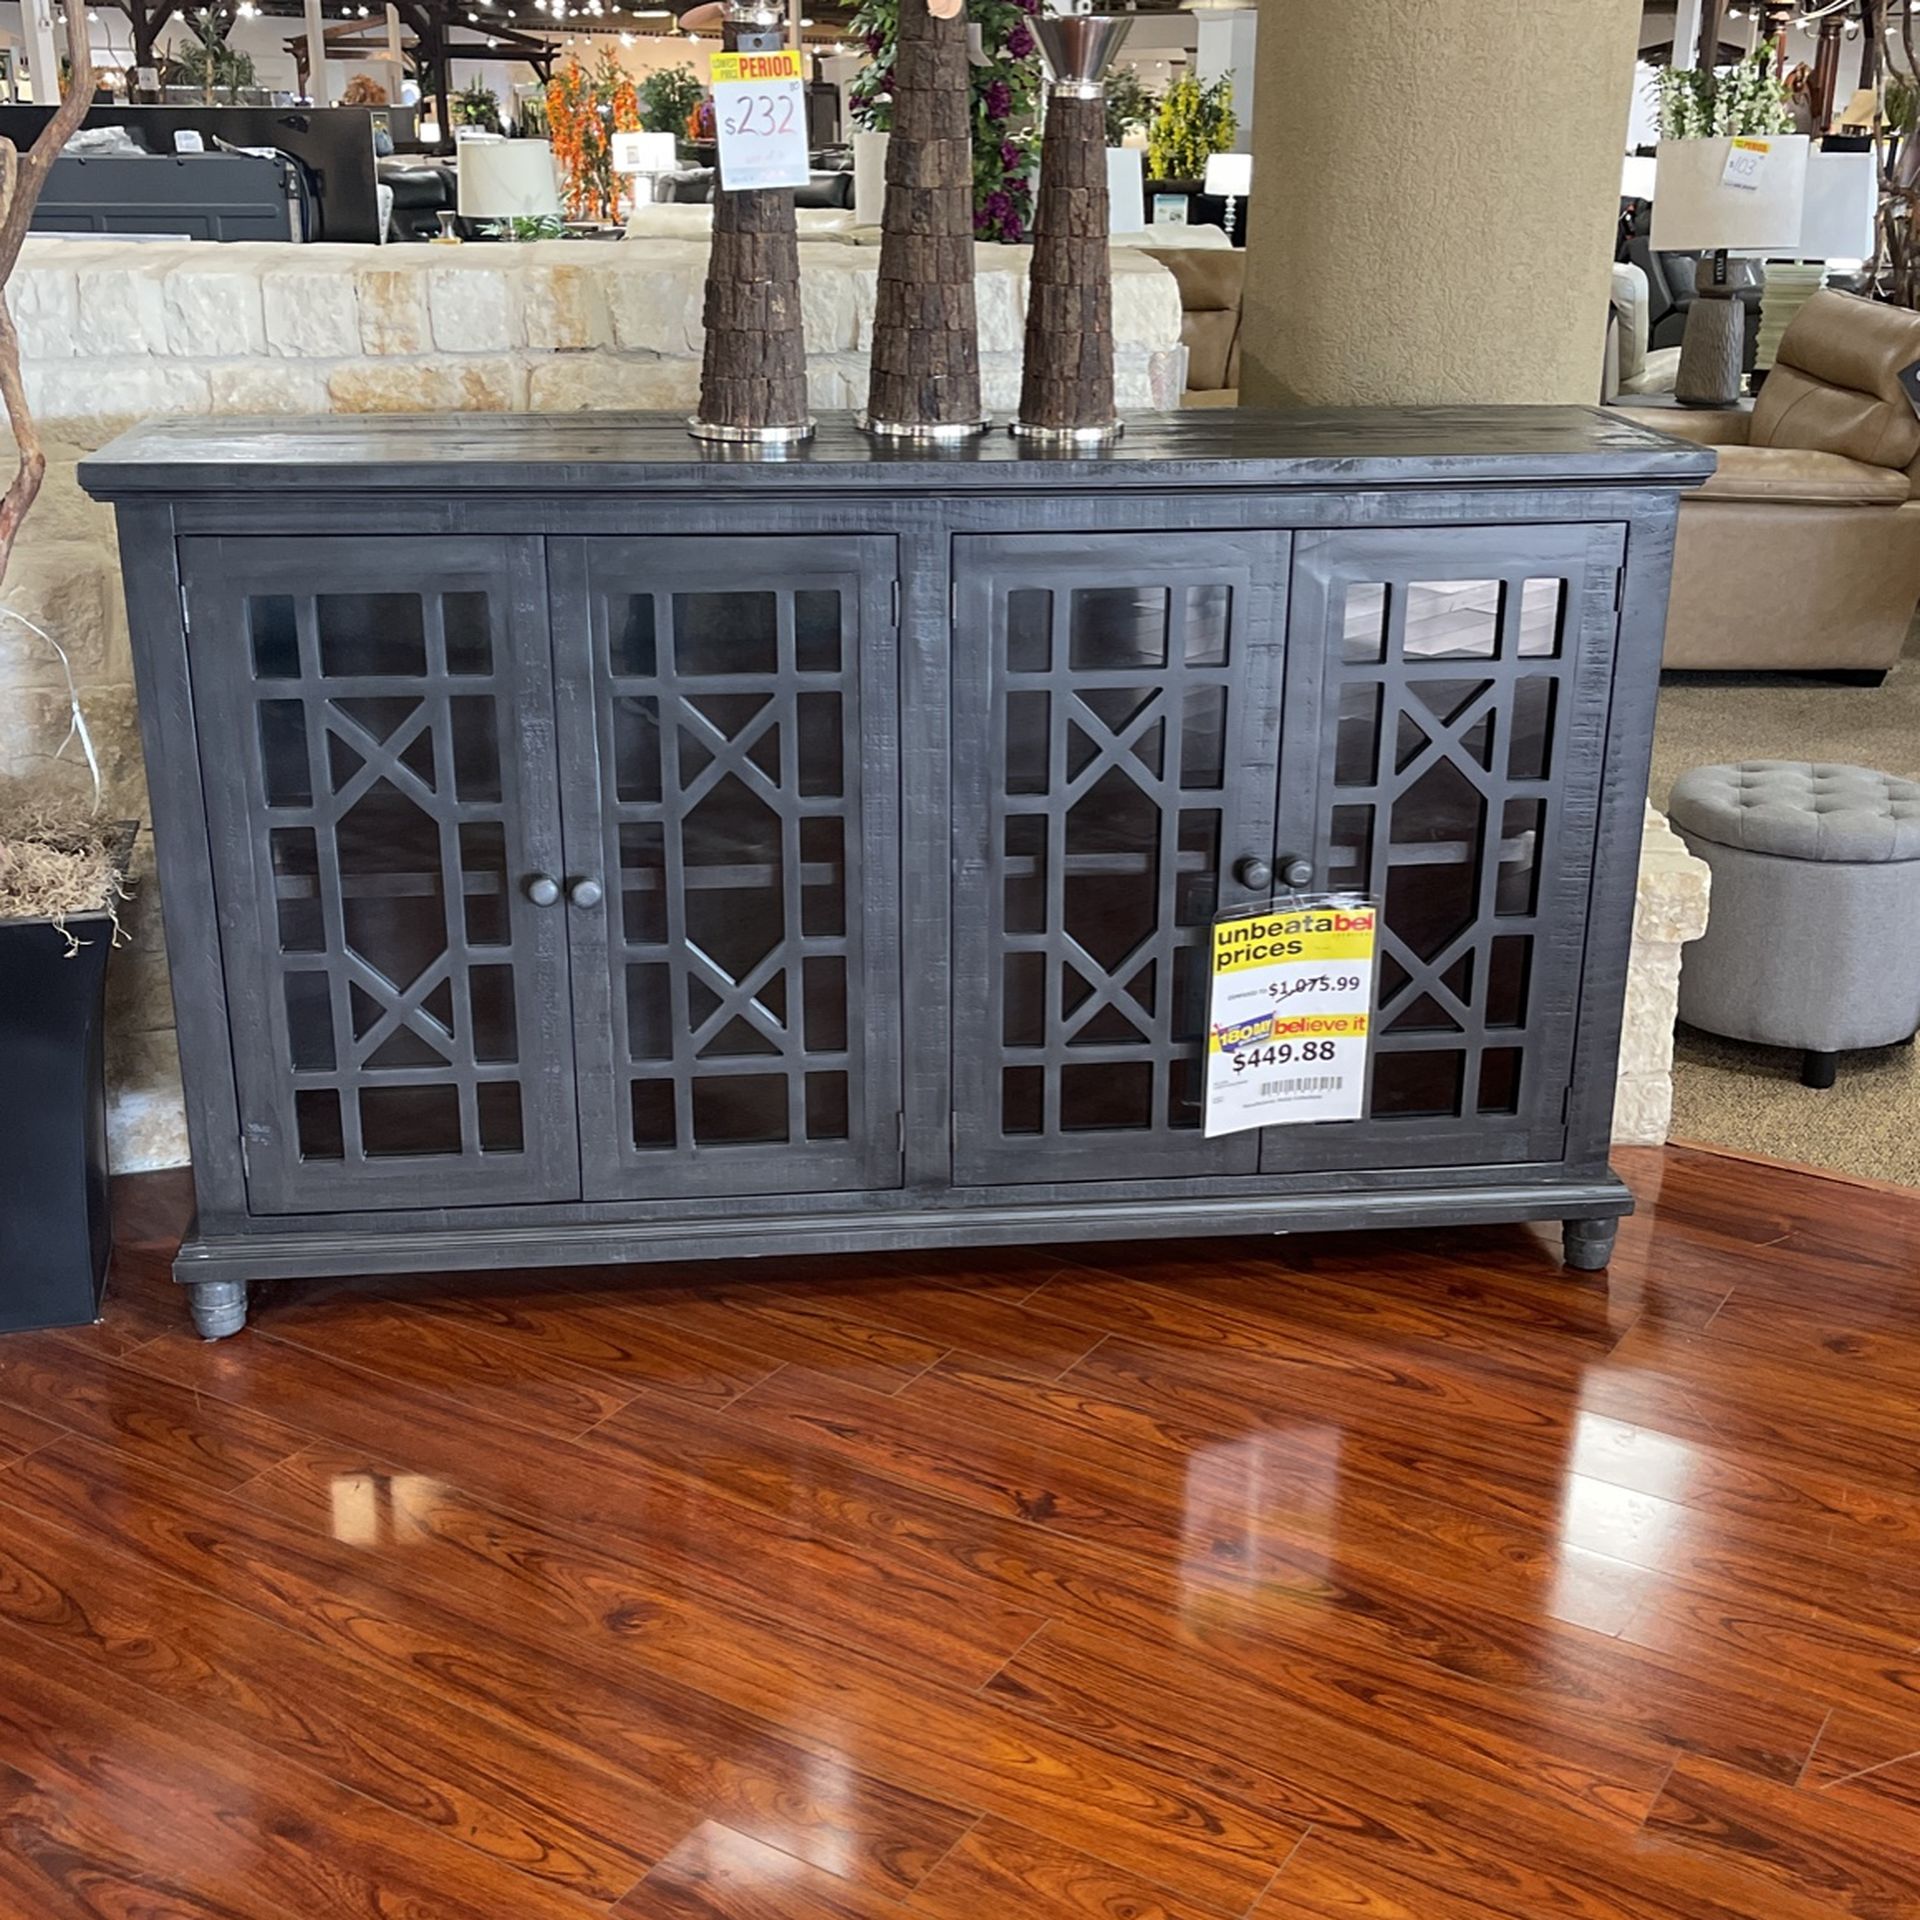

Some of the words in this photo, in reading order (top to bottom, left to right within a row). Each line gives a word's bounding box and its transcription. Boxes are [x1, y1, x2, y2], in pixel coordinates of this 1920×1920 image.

[739, 56, 798, 78] PERIOD.
[724, 95, 796, 136] $232
[1217, 913, 1373, 946] unbeatabel
[1216, 938, 1303, 972] prices
[1268, 976, 1360, 1000] $1,075.99
[1274, 1016, 1348, 1035] believe
[1353, 1015, 1366, 1033] it
[1232, 1041, 1336, 1076] $449.88
